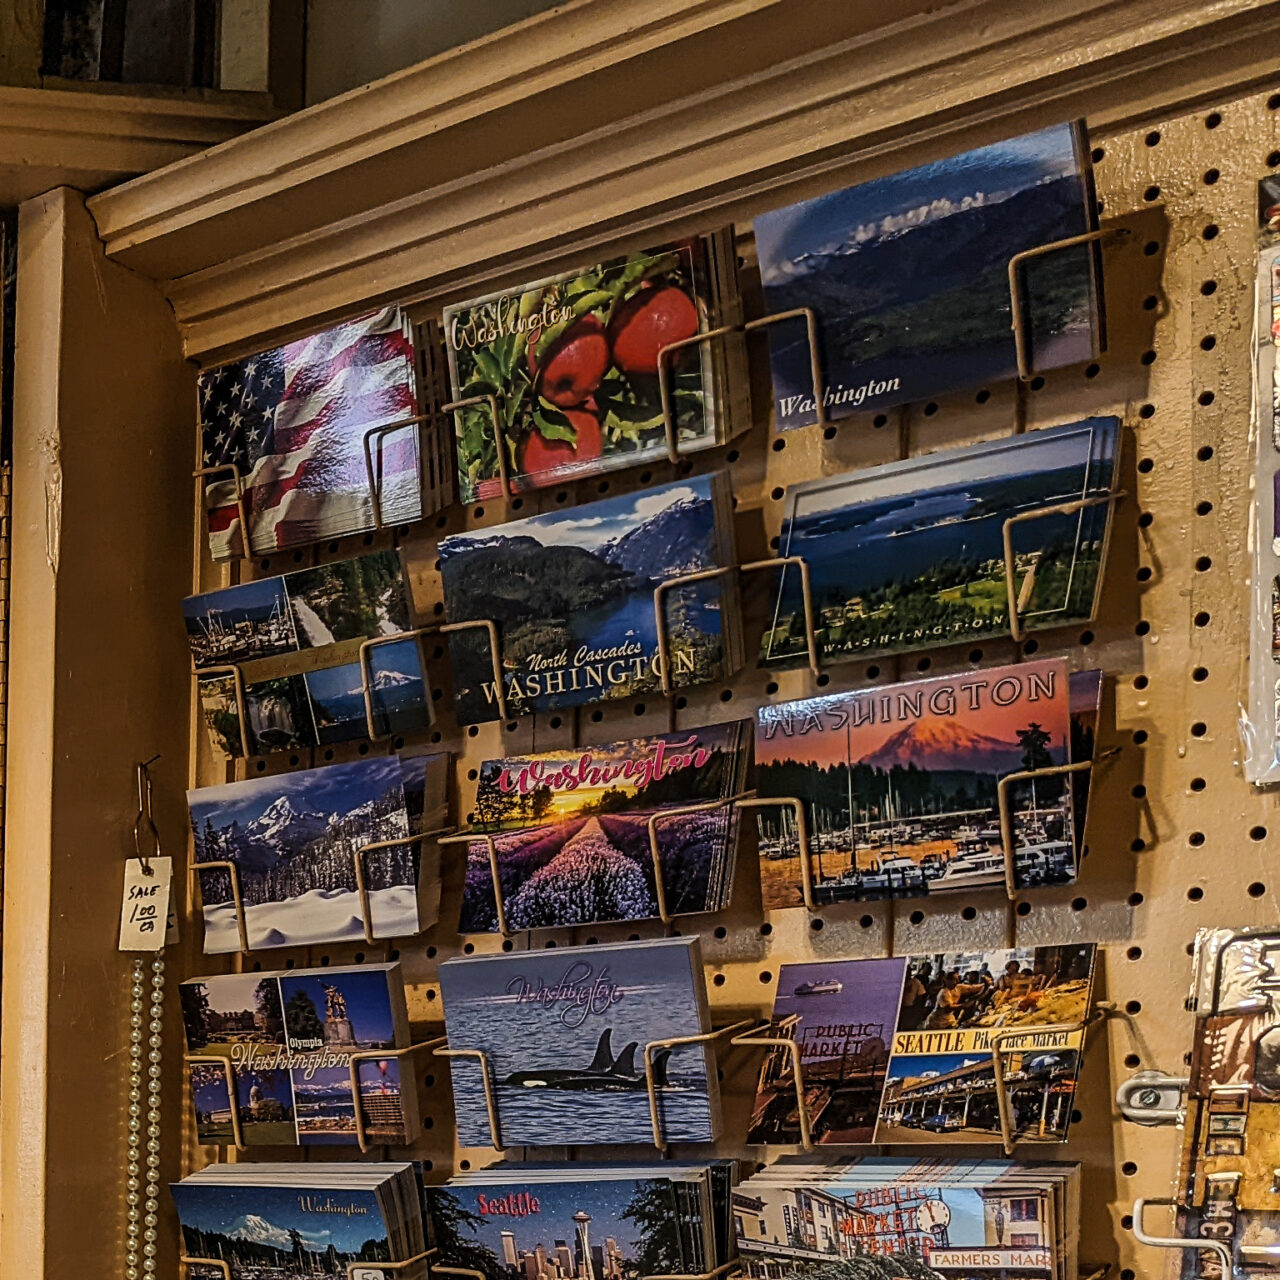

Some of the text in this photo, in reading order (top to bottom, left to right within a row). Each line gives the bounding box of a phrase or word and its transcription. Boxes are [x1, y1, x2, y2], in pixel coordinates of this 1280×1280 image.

[451, 295, 576, 350] Washington
[526, 640, 642, 673] North Cascades
[482, 648, 696, 704] WASHINGTON
[764, 671, 1056, 740] WASHINGTON
[497, 735, 715, 794] Washington
[128, 885, 161, 900] SALE
[508, 961, 624, 1028] Washington
[289, 1037, 324, 1051] Olympia
[814, 1022, 873, 1041] PUBLIC
[894, 1031, 965, 1055] SEATTLE
[231, 1043, 352, 1080] Washington
[801, 1039, 863, 1058] MARKET
[297, 1195, 367, 1216] Washington
[477, 1193, 540, 1217] Seattle
[841, 1208, 916, 1236] MARKET
[933, 1253, 1001, 1267] FARMERS
